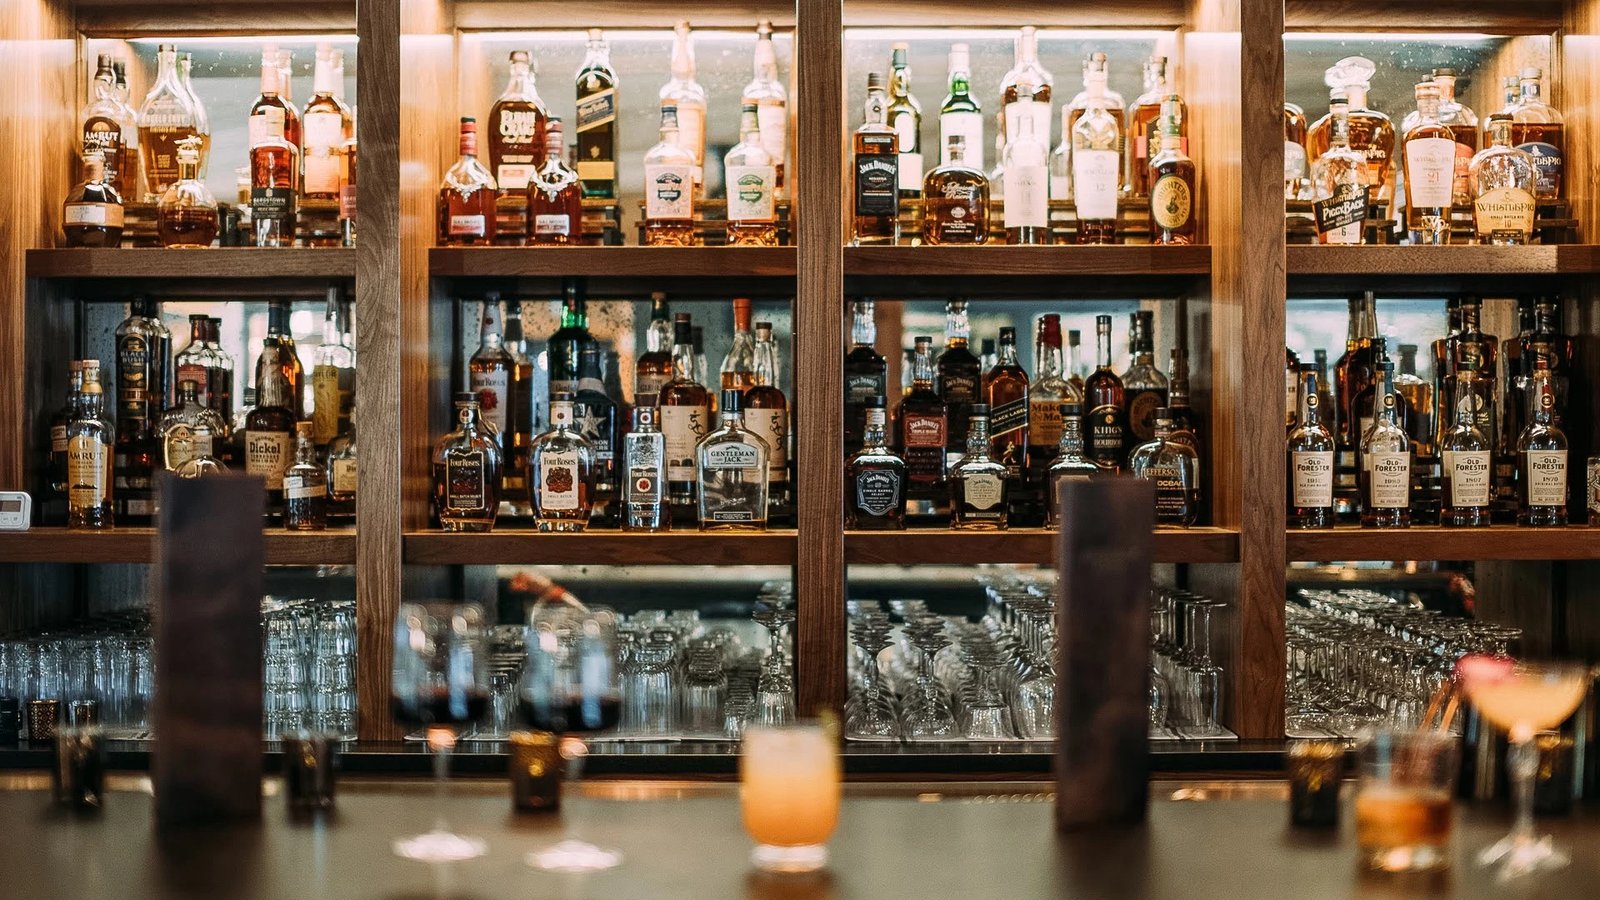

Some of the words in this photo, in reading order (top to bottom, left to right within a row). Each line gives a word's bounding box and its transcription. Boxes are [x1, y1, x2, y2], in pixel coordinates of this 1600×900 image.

[859, 163, 874, 175] JACK
[1477, 202, 1534, 213] WHISTLEPIG
[991, 412, 1011, 424] BLACK
[1010, 407, 1028, 418] LABEL
[909, 420, 921, 431] JACK
[920, 418, 940, 430] DANIEL'S
[249, 442, 281, 454] Dickel
[69, 451, 104, 460] AMRUT
[450, 458, 463, 467] Four
[462, 458, 480, 467] Roses
[543, 457, 557, 466] Four
[556, 457, 576, 466] Roses
[866, 476, 876, 484] JACK
